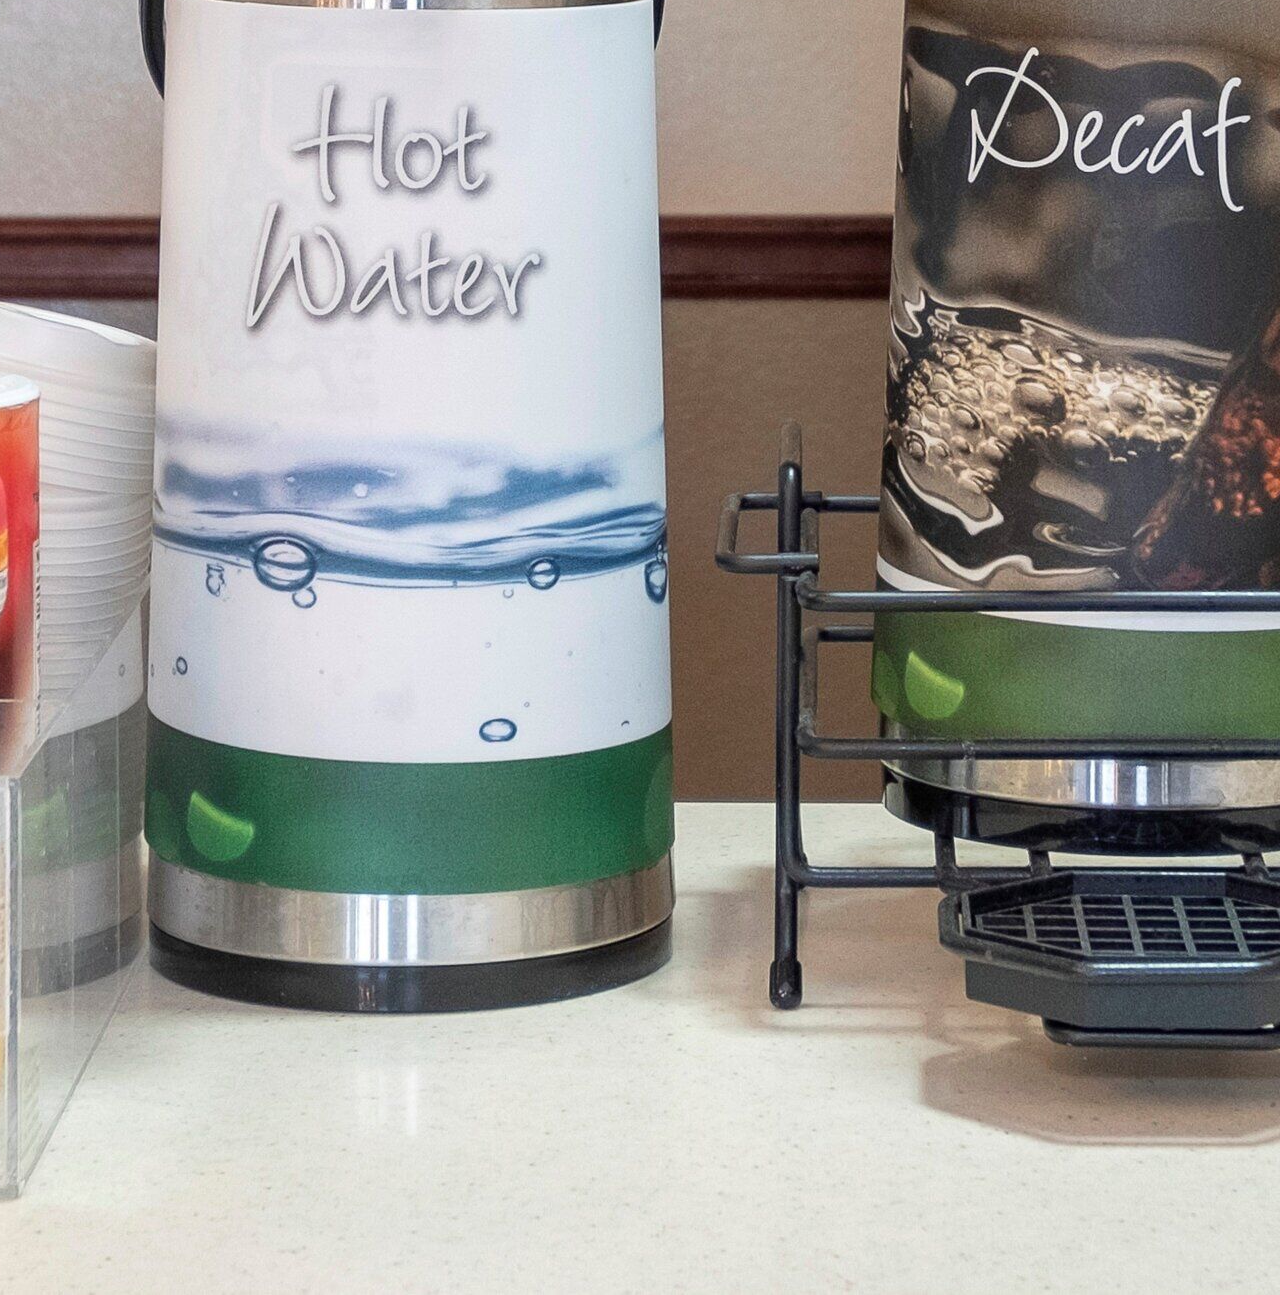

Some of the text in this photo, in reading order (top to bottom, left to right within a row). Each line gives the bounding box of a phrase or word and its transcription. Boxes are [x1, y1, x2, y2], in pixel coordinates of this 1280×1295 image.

[292, 83, 488, 203] Hot
[964, 46, 1252, 213] Decaf
[245, 201, 542, 329] Water
